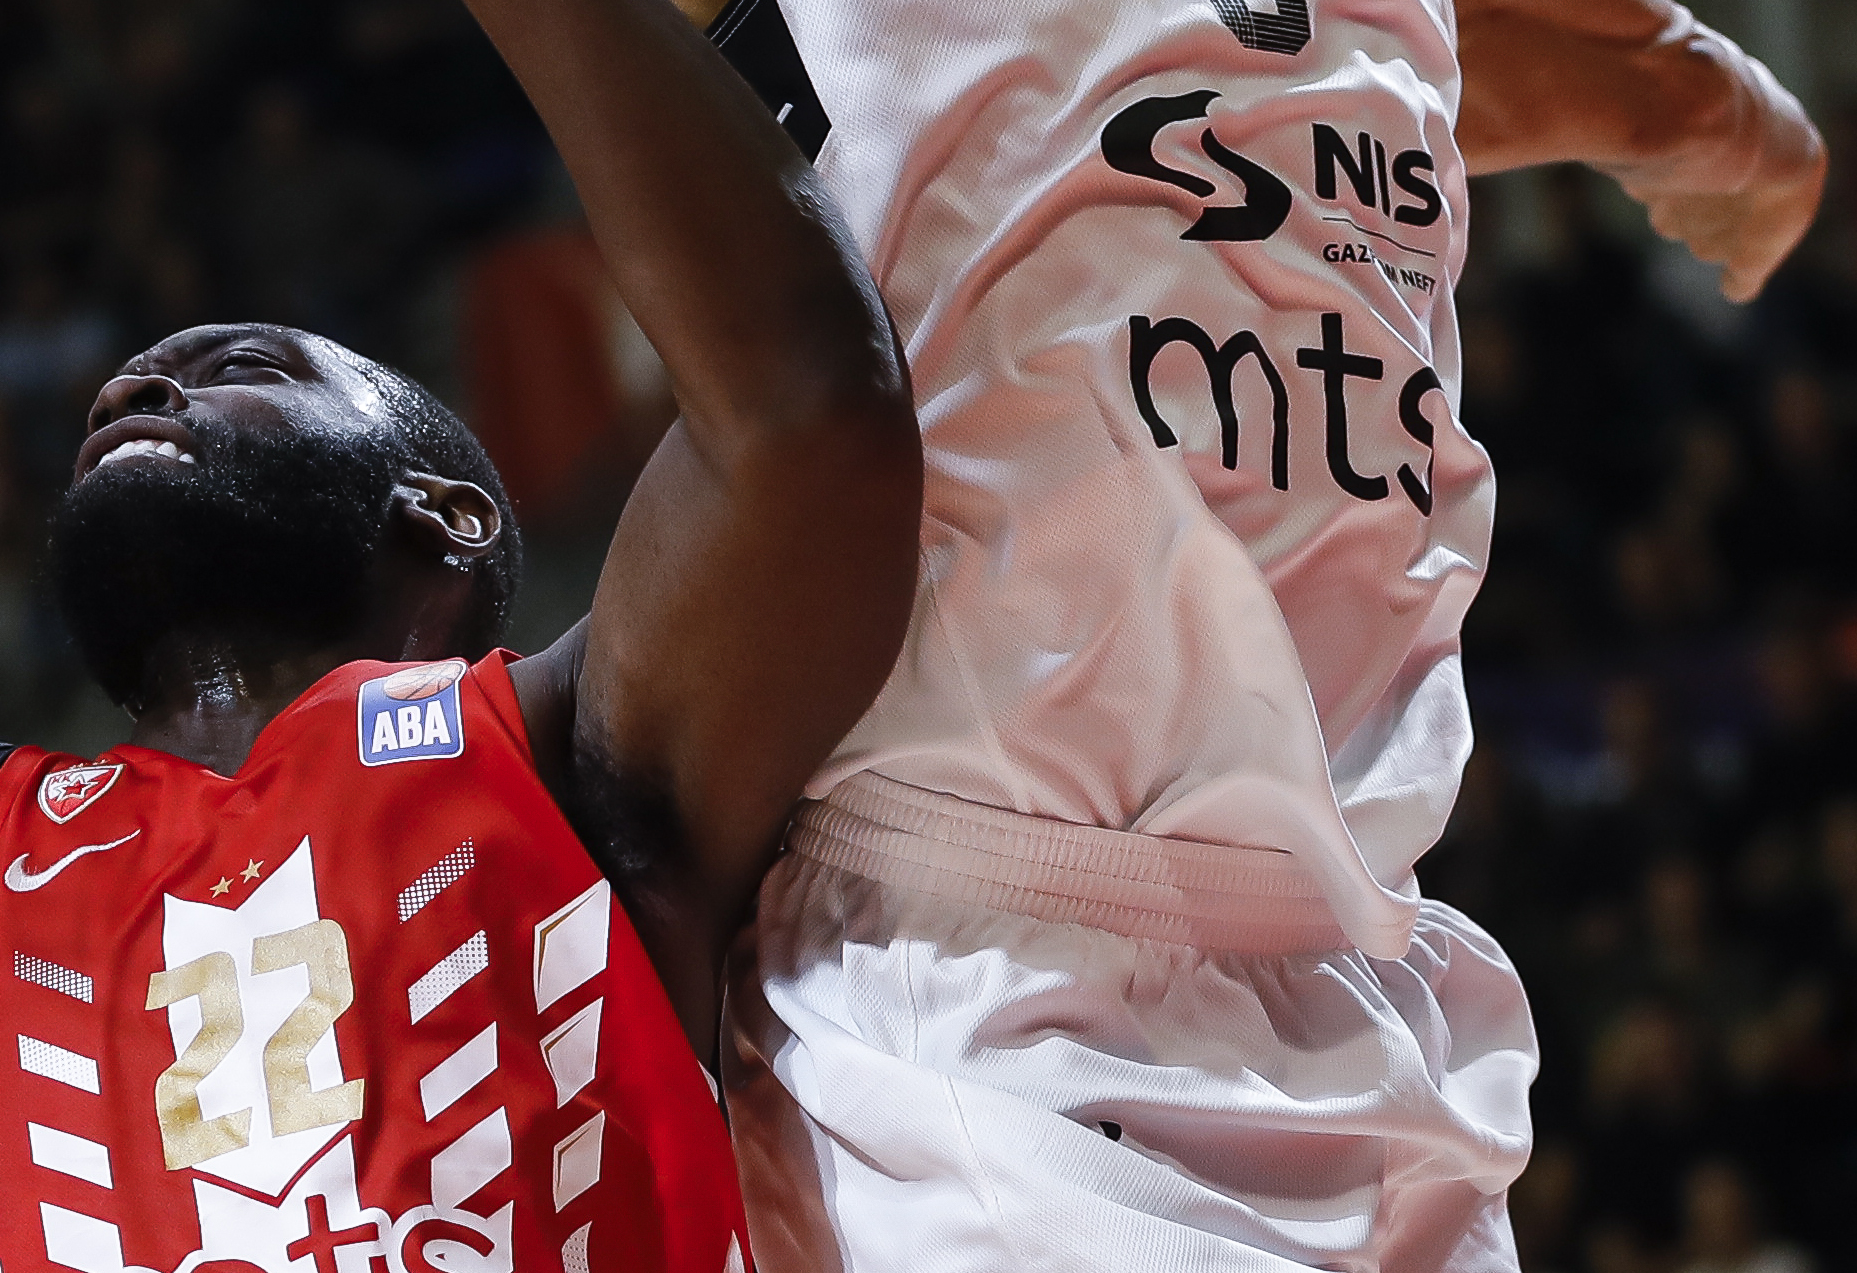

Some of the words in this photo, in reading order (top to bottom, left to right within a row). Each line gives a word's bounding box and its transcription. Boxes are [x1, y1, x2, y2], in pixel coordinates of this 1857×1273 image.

[1311, 121, 1443, 227] NIS
[1128, 312, 1444, 517] mts
[371, 699, 452, 754] ABA
[144, 917, 366, 1172] 22
